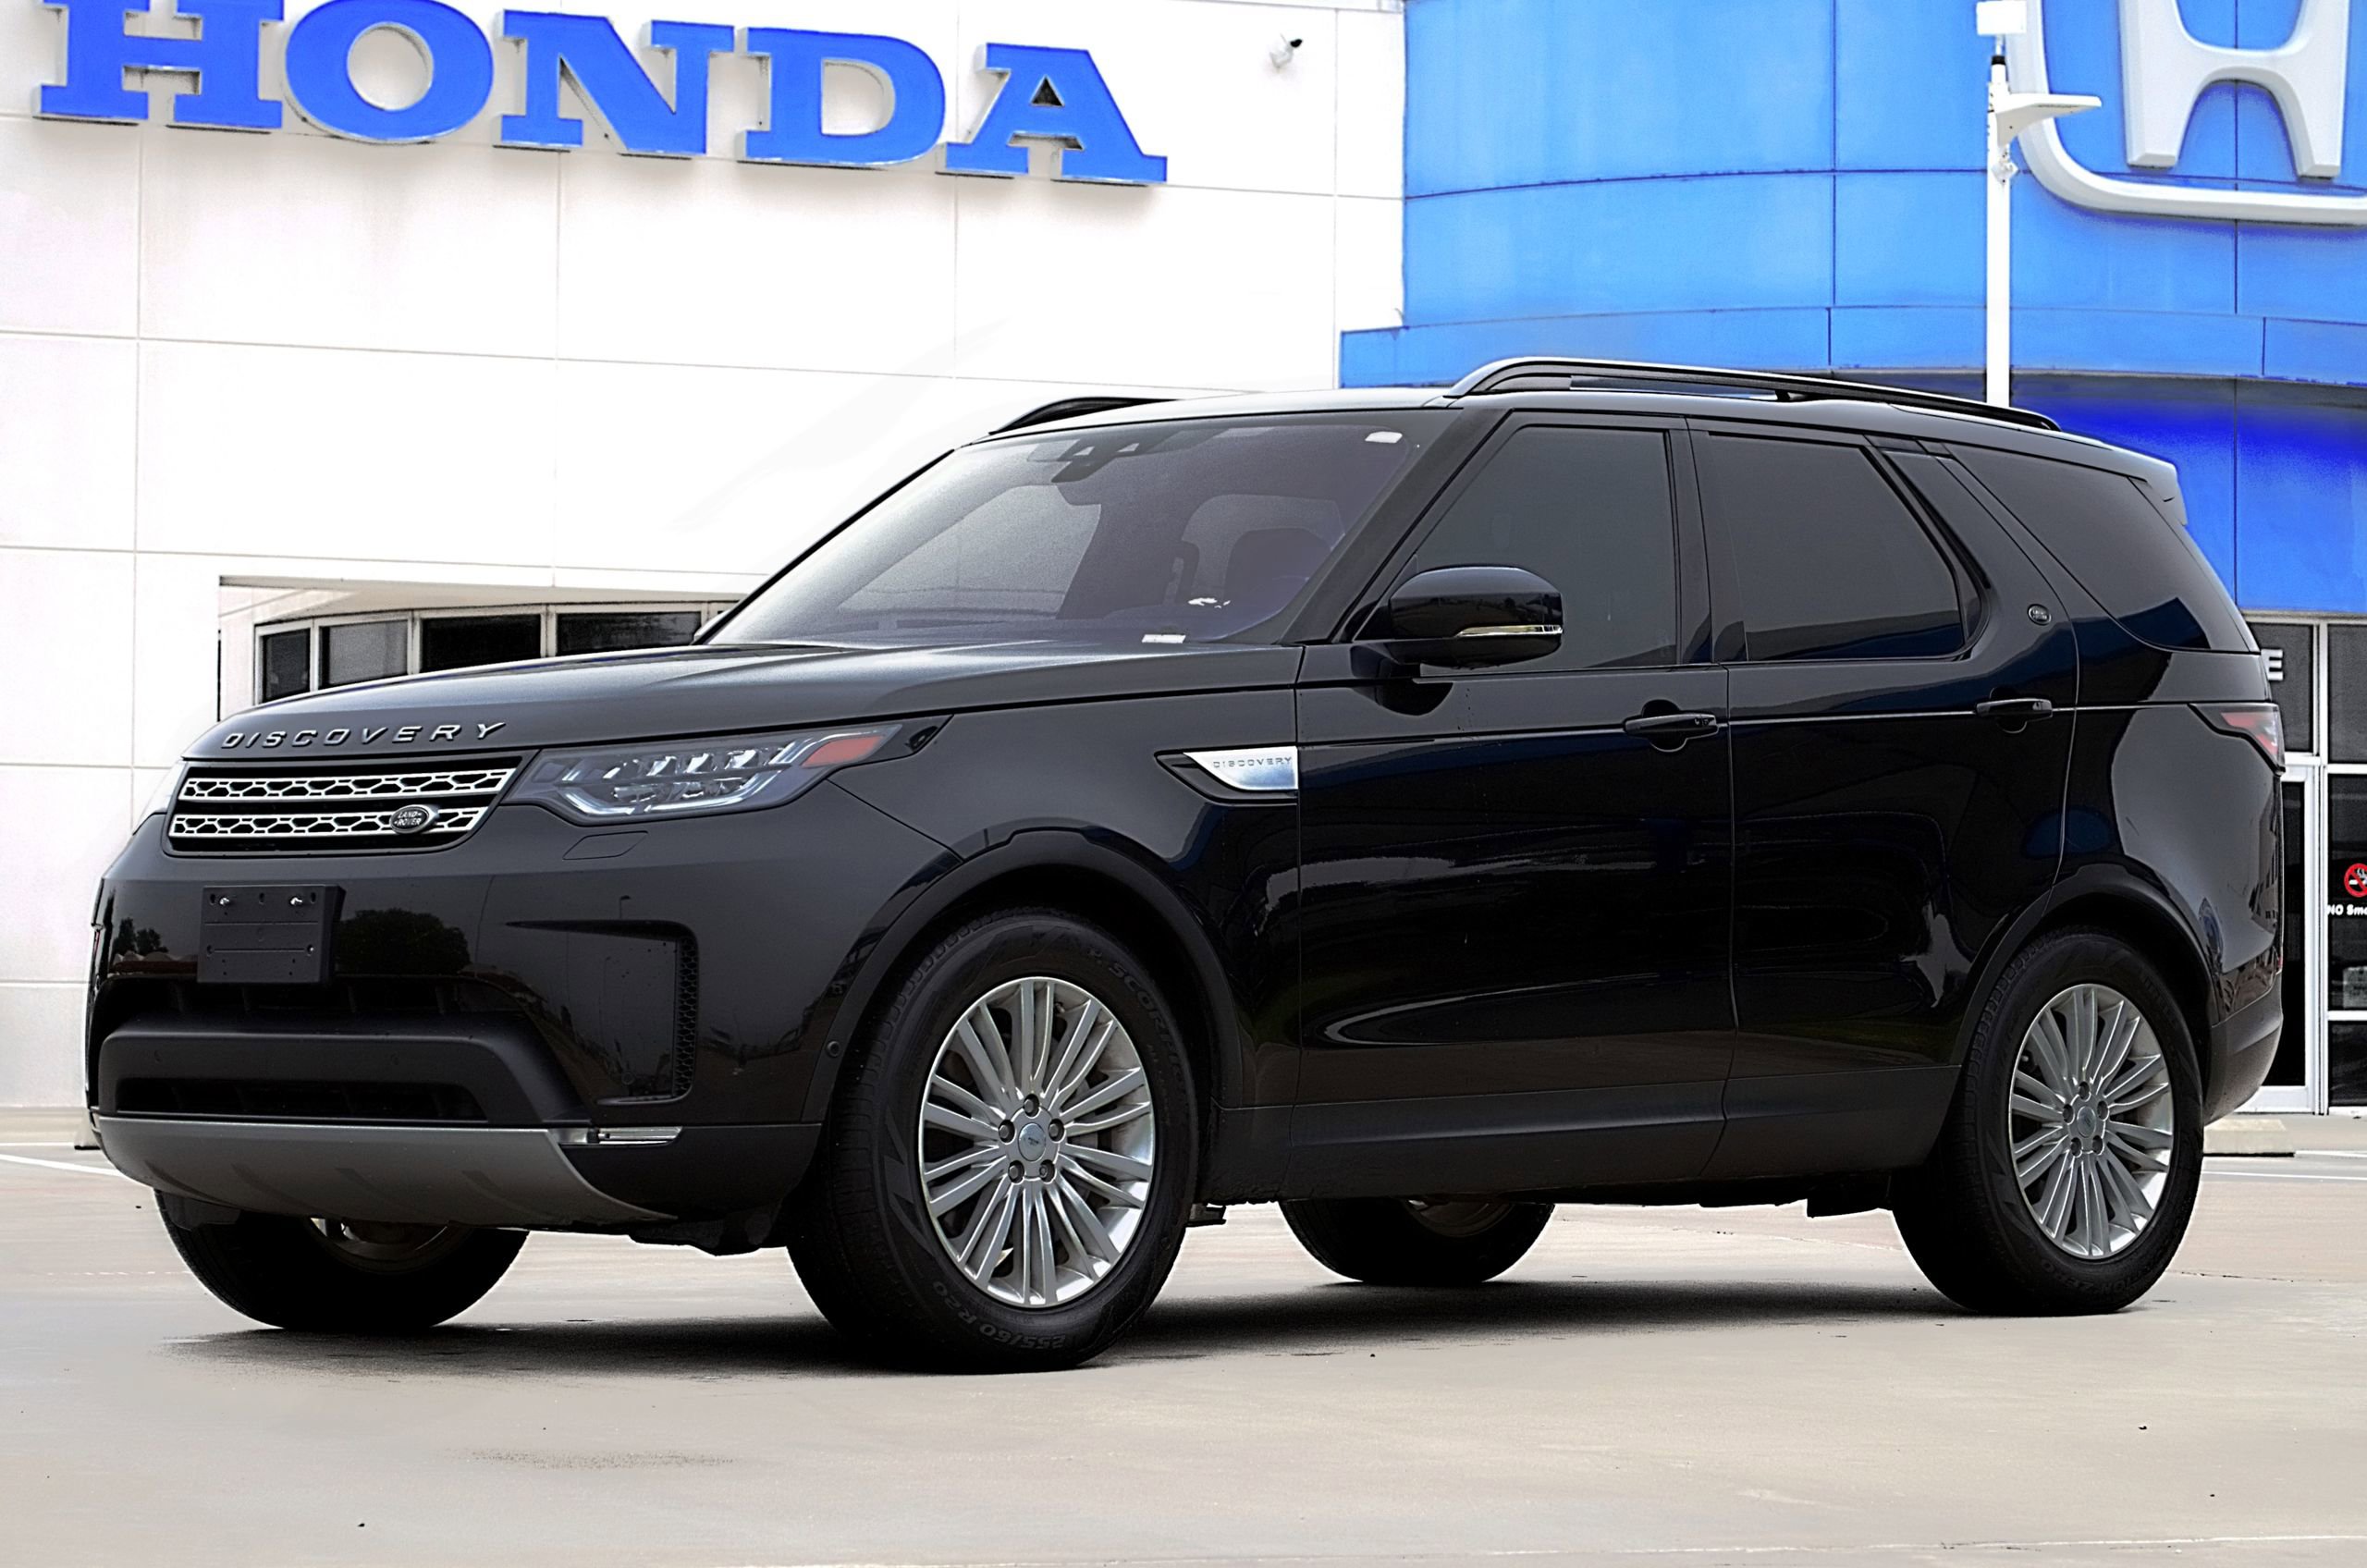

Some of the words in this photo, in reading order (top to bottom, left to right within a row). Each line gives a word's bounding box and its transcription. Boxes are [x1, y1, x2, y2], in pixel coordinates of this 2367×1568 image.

[41, 0, 1167, 181] HONDA
[221, 722, 506, 748] DISCOVERY
[1213, 756, 1292, 768] DISCOVERY
